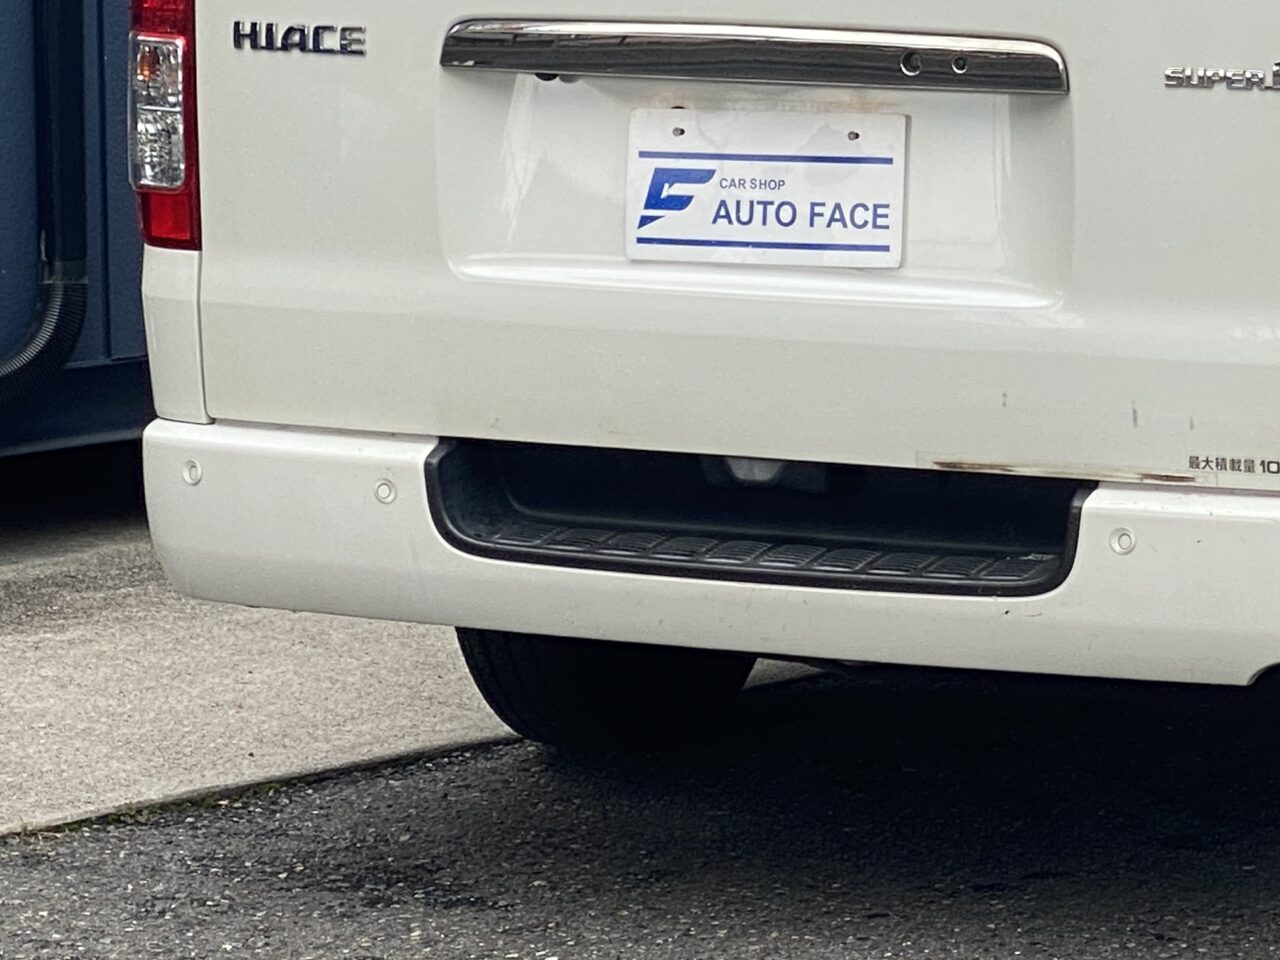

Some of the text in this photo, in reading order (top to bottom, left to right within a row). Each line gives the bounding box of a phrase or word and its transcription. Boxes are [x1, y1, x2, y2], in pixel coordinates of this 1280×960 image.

[233, 21, 366, 56] HIACE
[719, 177, 786, 191] CAR SHOP
[711, 199, 890, 230] AUTO FACE
[1188, 455, 1256, 474] 最大積載量
